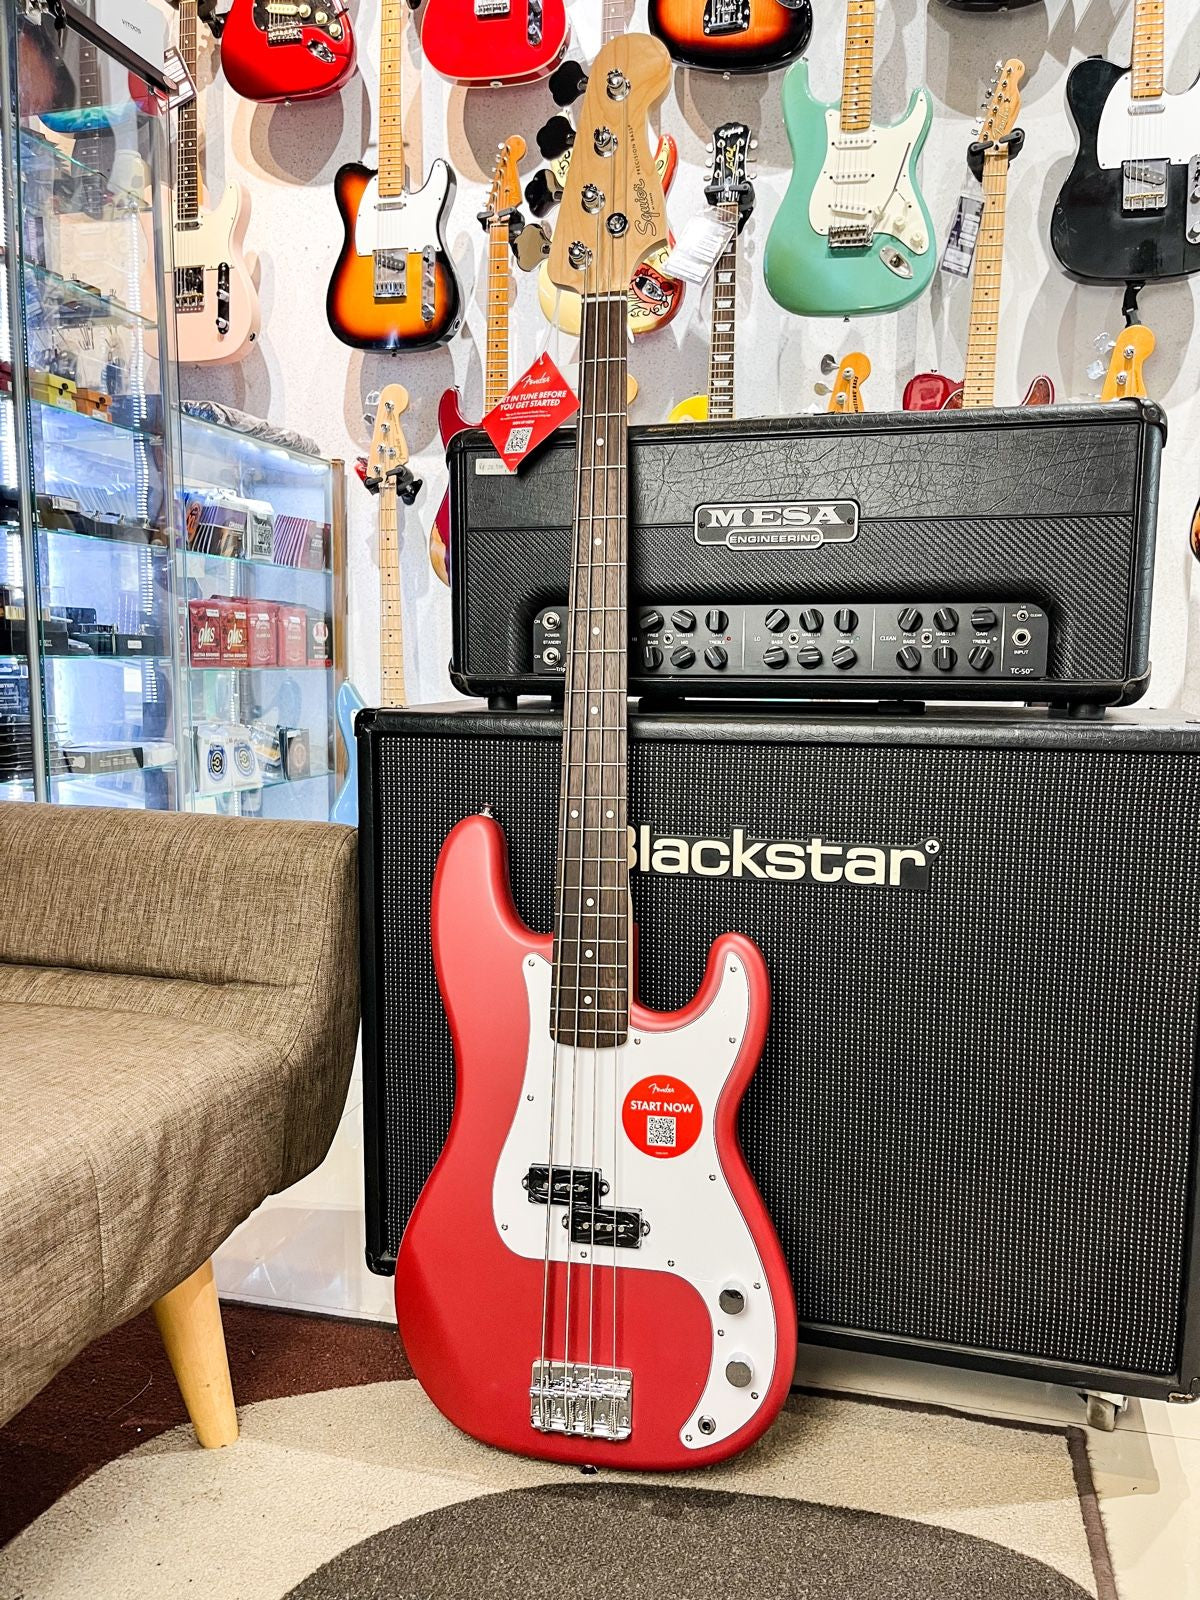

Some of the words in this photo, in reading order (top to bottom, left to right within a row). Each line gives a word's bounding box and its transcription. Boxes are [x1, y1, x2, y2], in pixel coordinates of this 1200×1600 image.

[632, 143, 641, 175] PRECISION
[633, 178, 661, 237] Squier
[521, 372, 551, 388] Fender
[520, 392, 539, 401] TUNE
[539, 390, 568, 399] BEFORE
[500, 403, 516, 411] YOU
[516, 401, 531, 409] GET
[529, 399, 561, 408] STARTED
[706, 506, 845, 528] MESA
[729, 534, 820, 544] ENGINEERING
[198, 621, 216, 649] ghs
[227, 623, 244, 650] ghs
[648, 1083, 675, 1094] Fender
[630, 1100, 662, 1111] START
[663, 1102, 694, 1113] NOW
